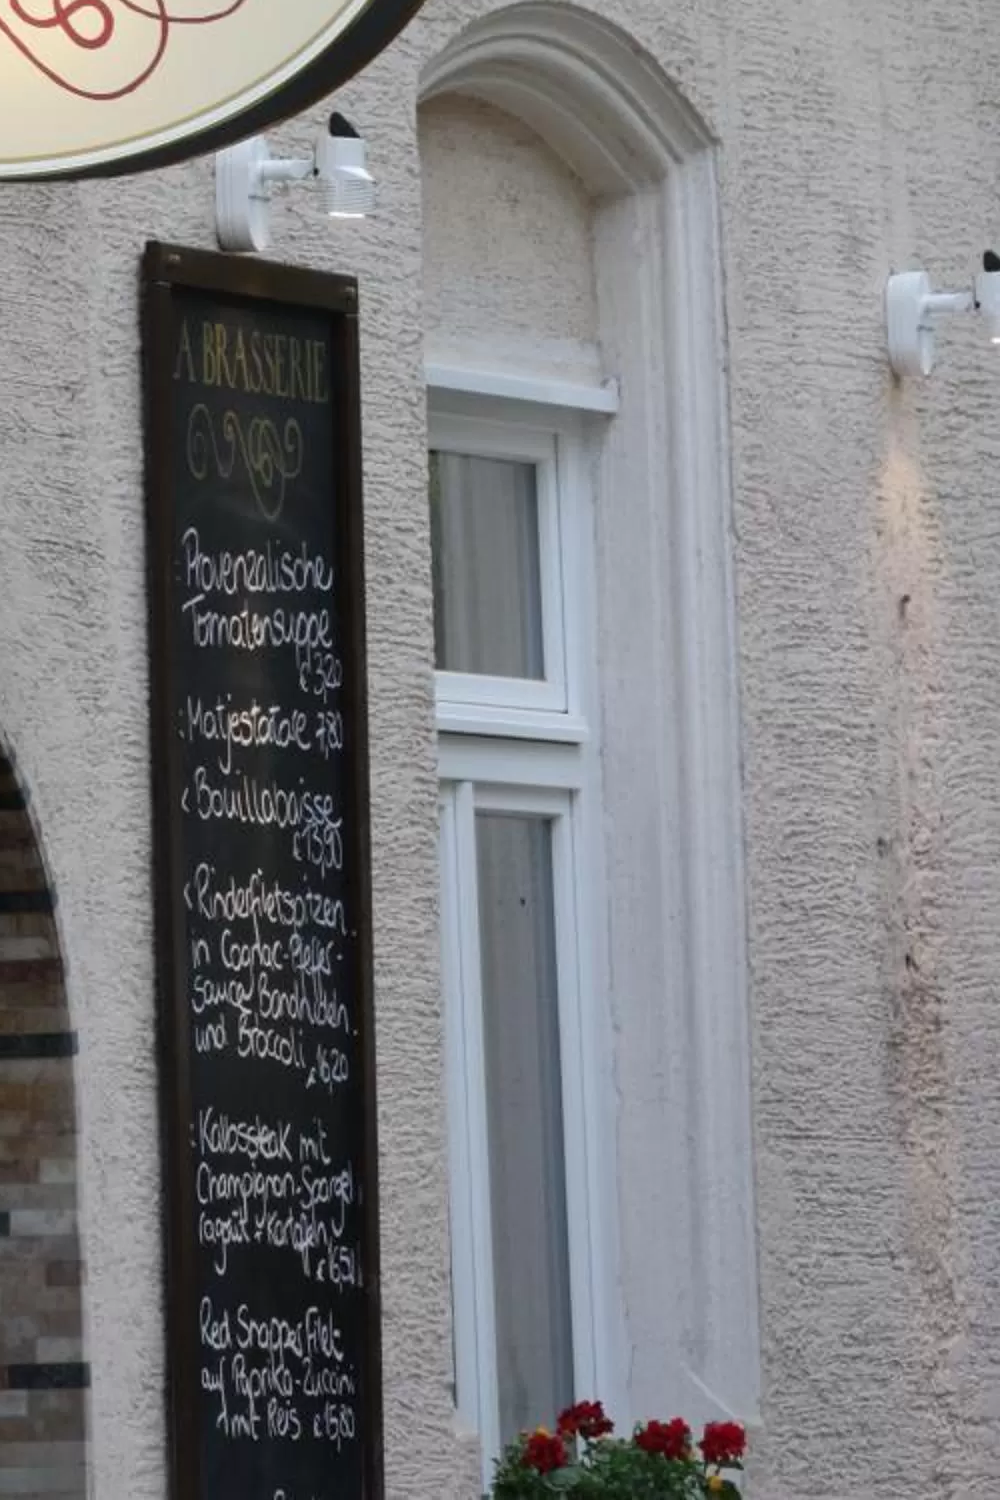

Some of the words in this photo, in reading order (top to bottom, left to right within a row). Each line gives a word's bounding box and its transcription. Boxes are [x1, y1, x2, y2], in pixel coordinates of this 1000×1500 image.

[202, 320, 329, 403] BRASSERIE
[181, 526, 334, 595] Provenzalische
[181, 593, 333, 672] Tomatensuppe
[195, 1012, 226, 1053] und
[237, 1011, 307, 1069] Broccoli
[300, 1116, 332, 1165] mit
[200, 1295, 232, 1350] Red
[236, 1304, 304, 1366] Snapper
[267, 1397, 302, 1441] Reis
